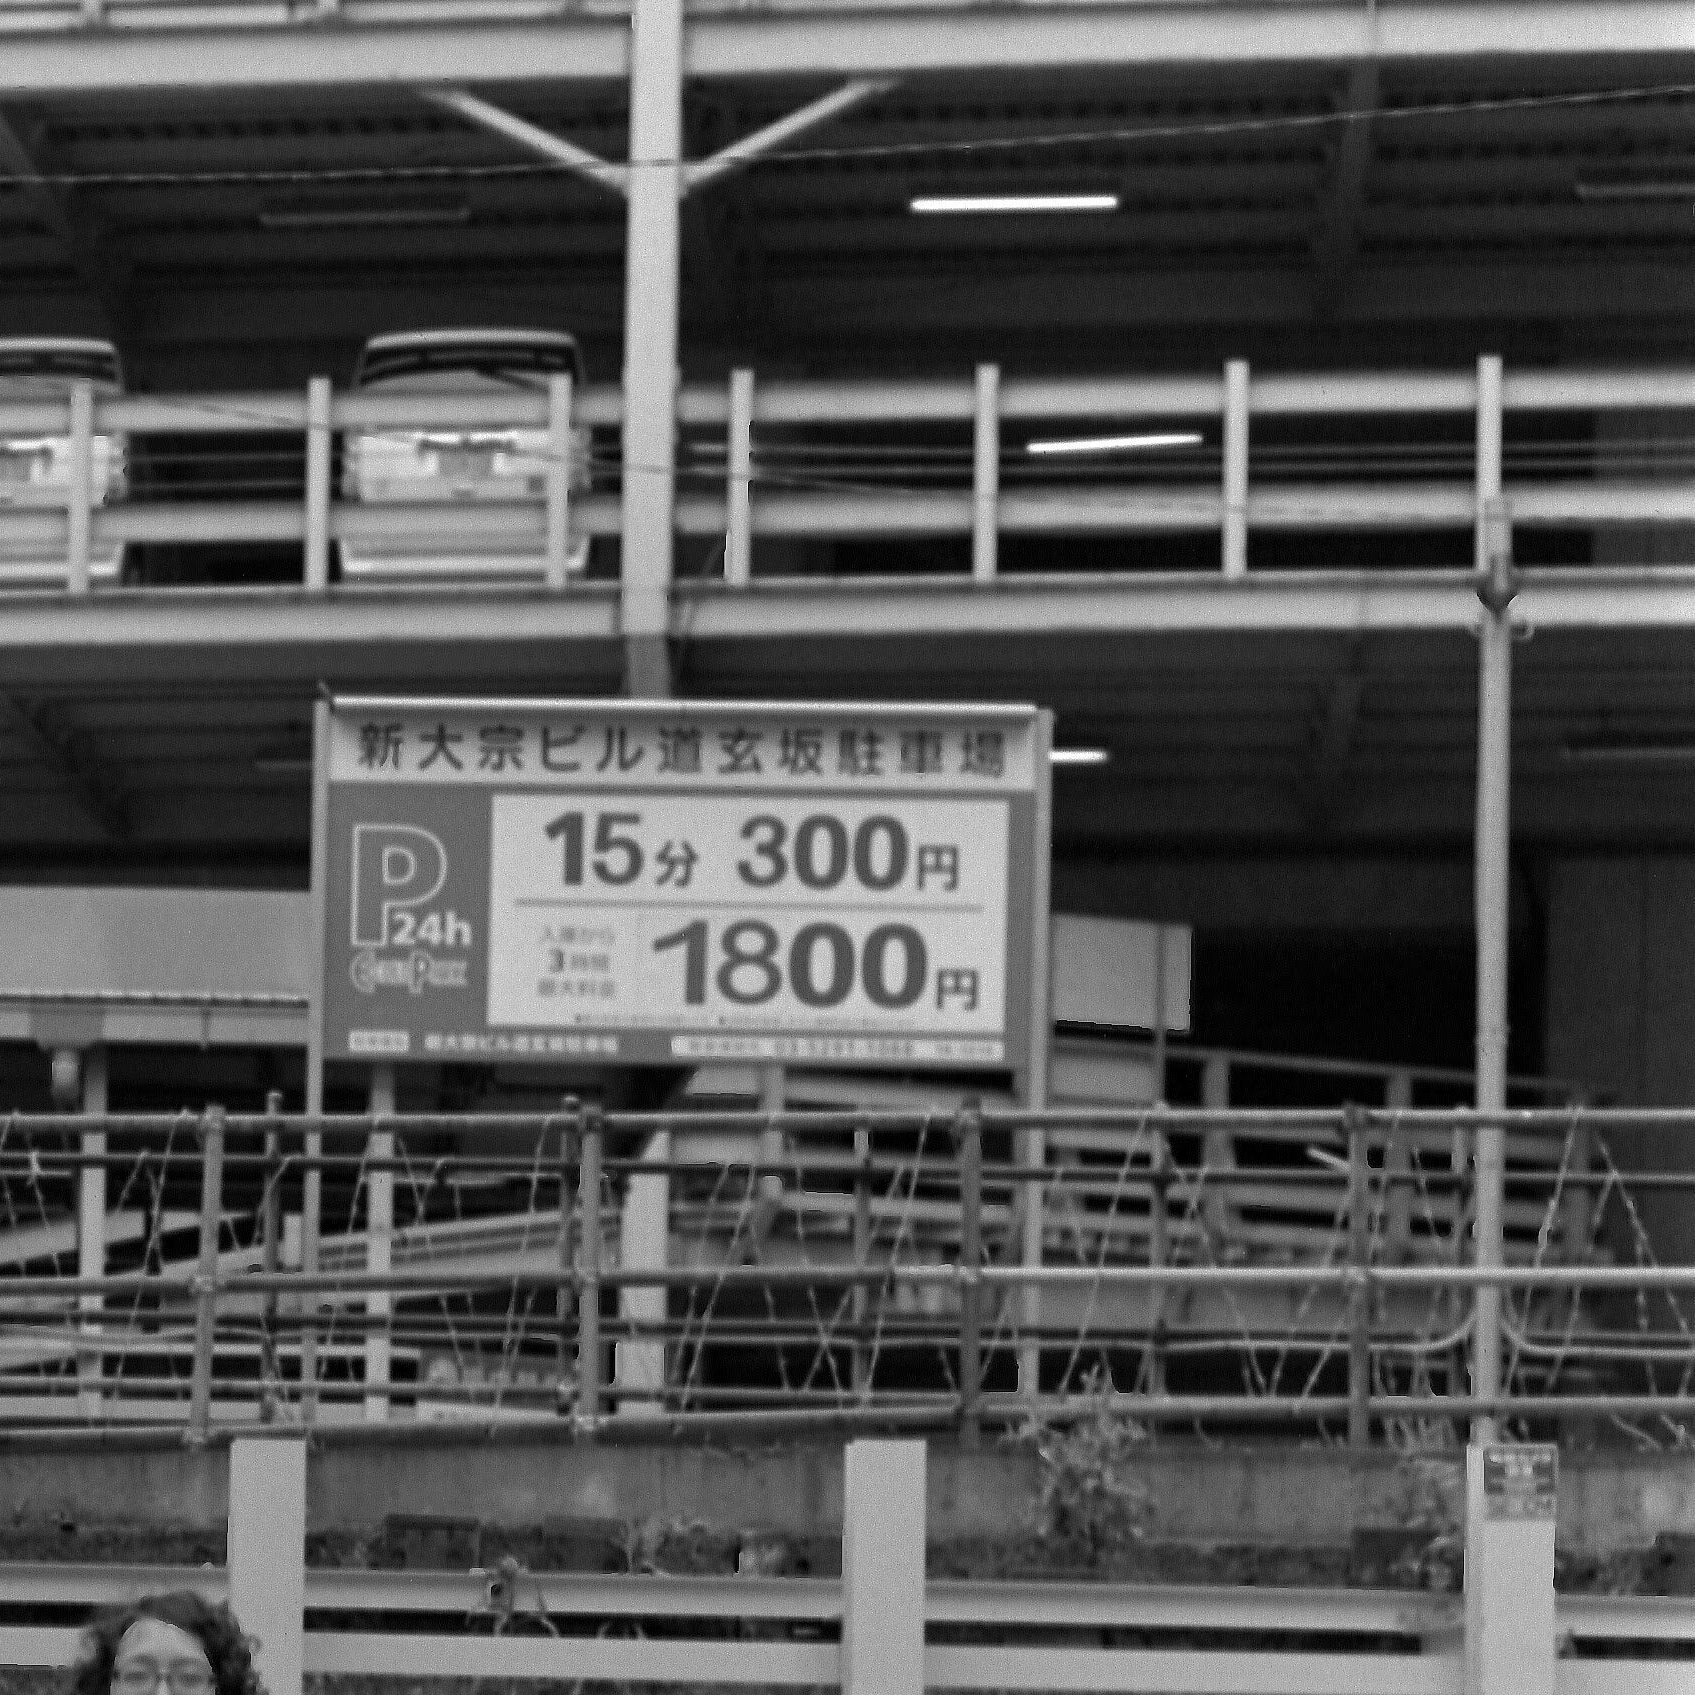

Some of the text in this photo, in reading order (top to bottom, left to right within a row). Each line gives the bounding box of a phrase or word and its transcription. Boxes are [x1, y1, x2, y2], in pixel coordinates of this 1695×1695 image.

[358, 722, 1005, 778] 新大宗ビル道玄坂駐車場
[351, 824, 448, 946] P
[544, 811, 961, 892] 15分 300円
[393, 911, 473, 946] 24h
[651, 919, 981, 1011] 1800円
